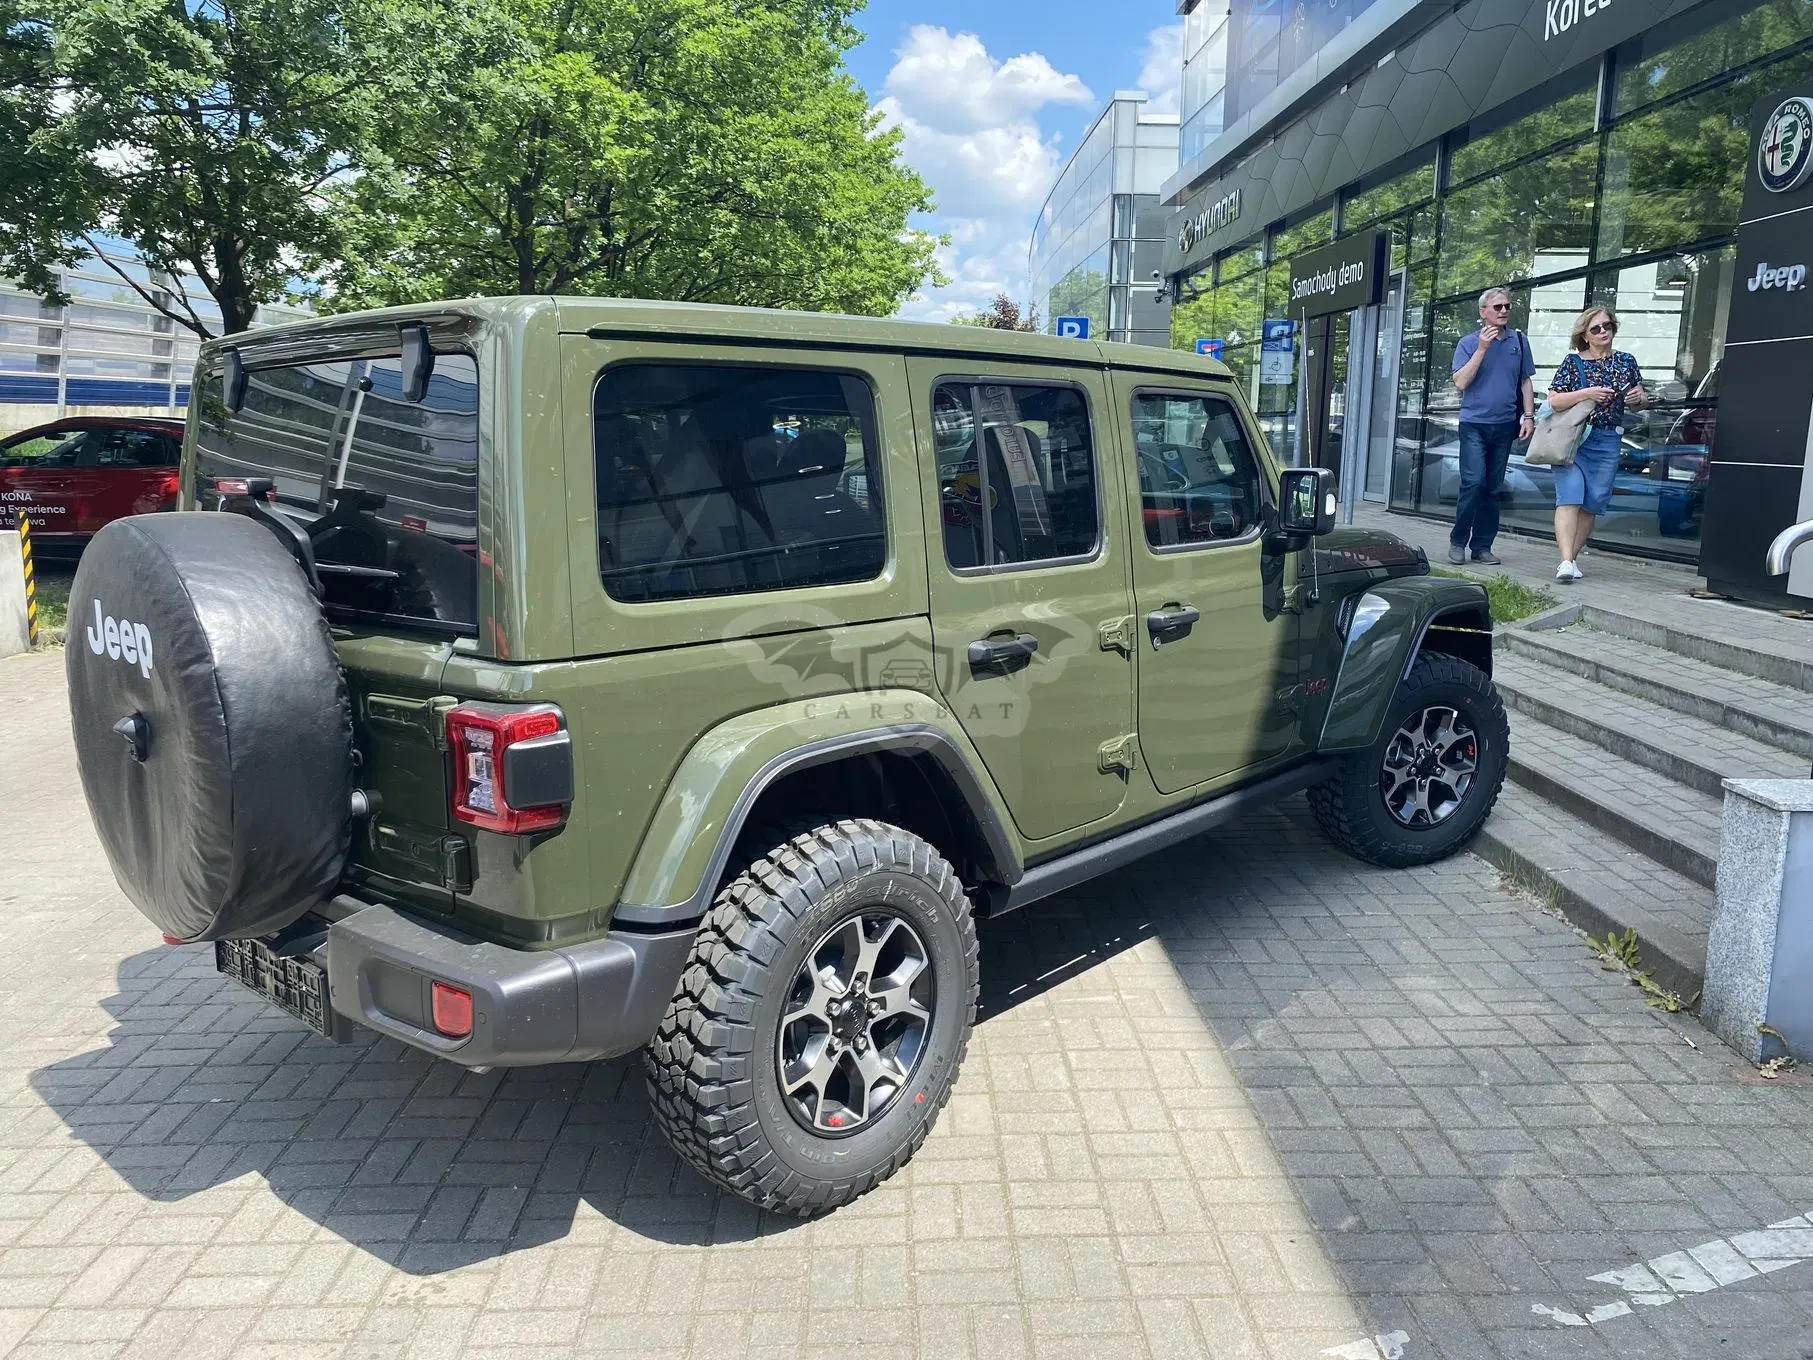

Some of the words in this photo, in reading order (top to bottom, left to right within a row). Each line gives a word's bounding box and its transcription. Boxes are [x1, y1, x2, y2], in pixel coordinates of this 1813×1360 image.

[1544, 0, 1612, 41] Kore
[1784, 103, 1811, 139] ROMEO
[1194, 188, 1241, 242] HYUNDAI
[1291, 265, 1337, 300] Samochody
[1338, 261, 1363, 286] demo
[1747, 262, 1806, 292] Jeep
[0, 492, 33, 501] KONA
[4, 517, 46, 526] tewa
[87, 598, 154, 679] Jeep
